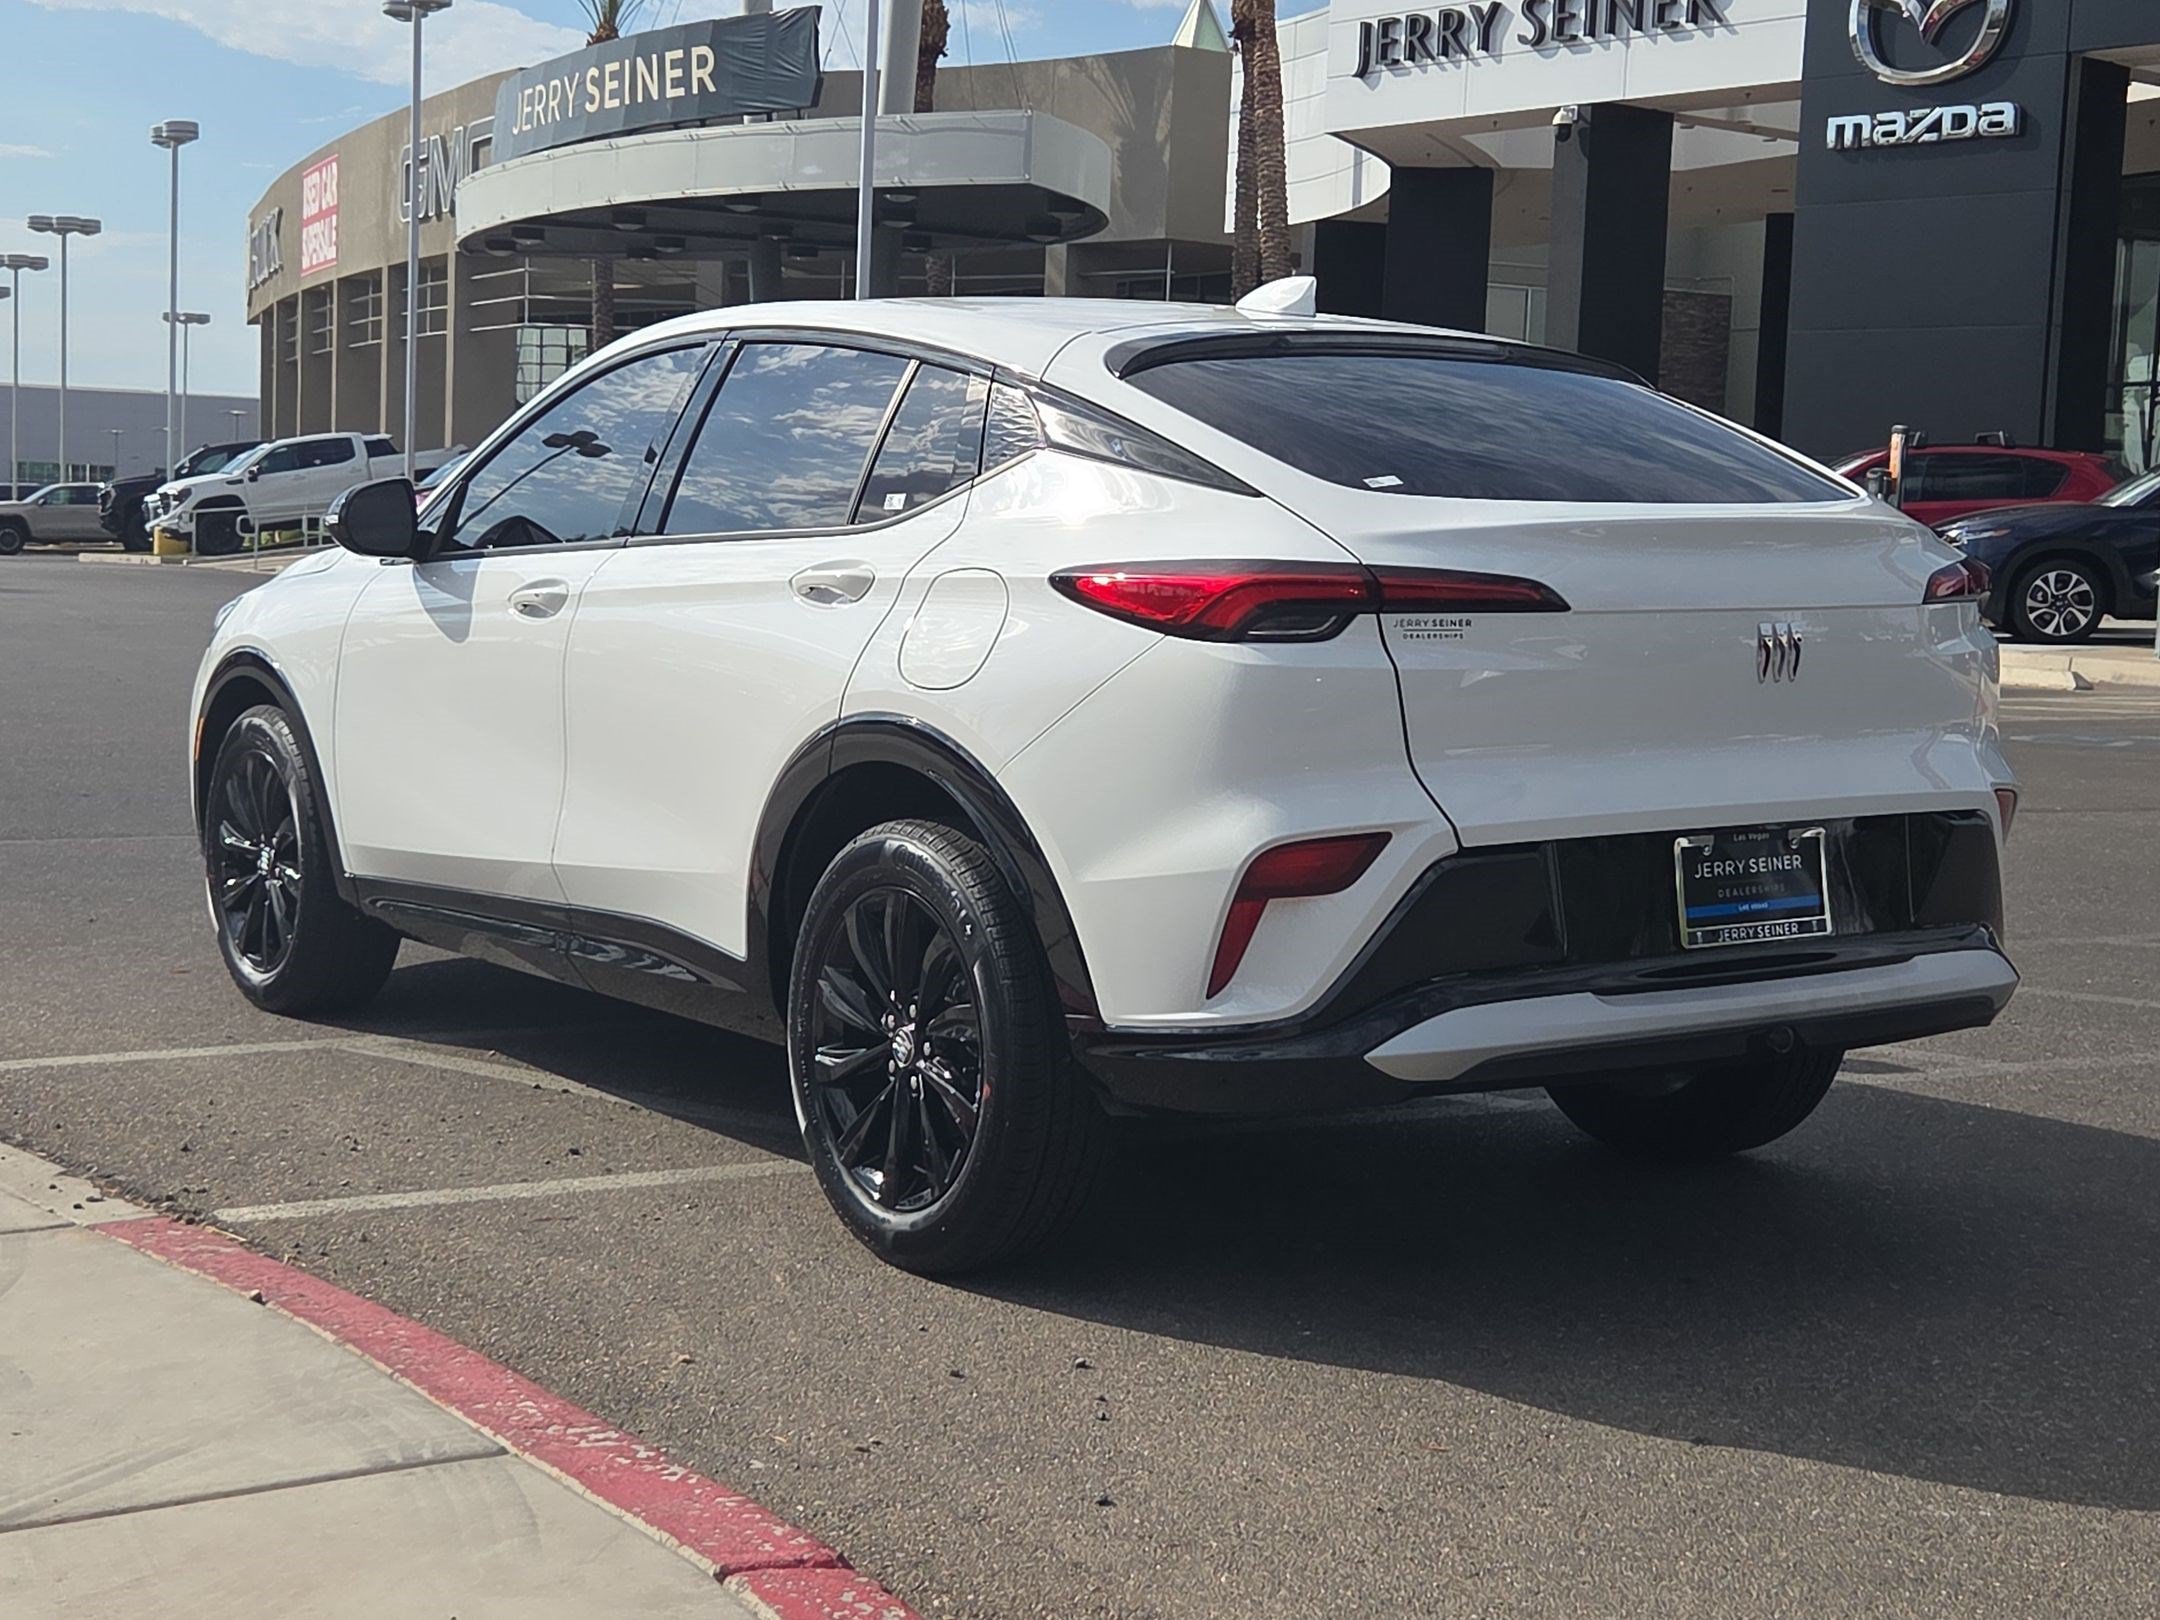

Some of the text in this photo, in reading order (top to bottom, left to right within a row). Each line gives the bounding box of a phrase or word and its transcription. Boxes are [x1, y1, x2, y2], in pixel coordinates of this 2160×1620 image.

[1351, 1, 1503, 78] JERRY
[512, 45, 717, 135] JERRY SEINER
[1393, 618, 1472, 628] JERRY SEINER
[1694, 855, 1802, 879] JERRY SEINER
[1717, 882, 1785, 898] DEALERSHIPS
[1718, 922, 1799, 943] JERRY SEINER
